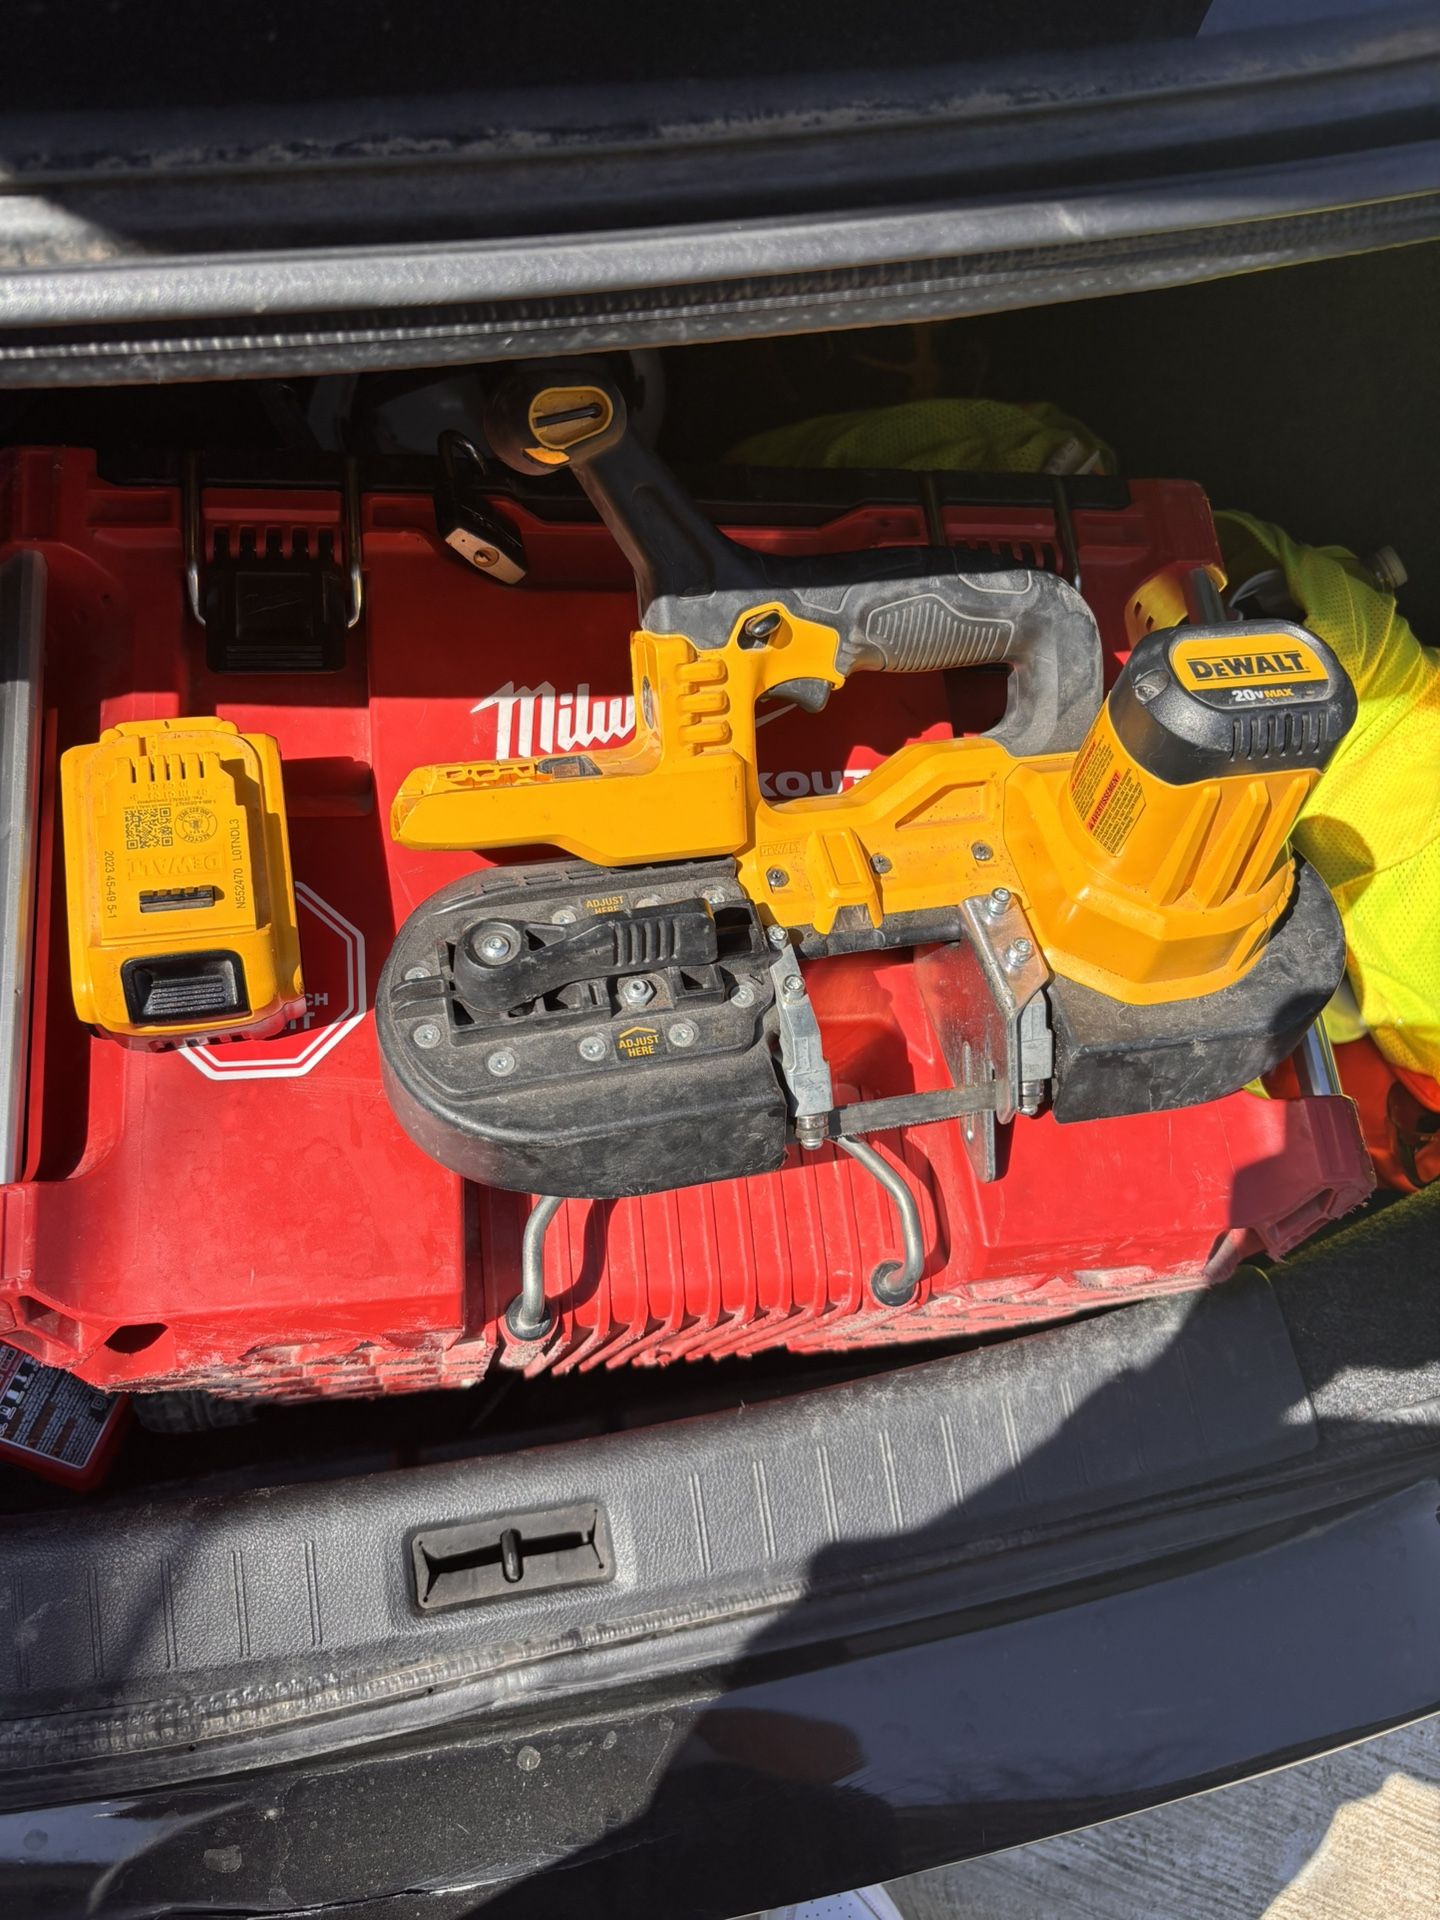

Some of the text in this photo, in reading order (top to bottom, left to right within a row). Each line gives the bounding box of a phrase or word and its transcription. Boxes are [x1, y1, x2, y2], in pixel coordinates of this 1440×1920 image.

[1187, 652, 1306, 680] DEWALT
[470, 681, 636, 760] Milw
[758, 769, 872, 797] KOUT
[1090, 771, 1120, 826] AVERTISSEMENT
[104, 850, 115, 873] 2023
[585, 896, 624, 909] ADJUST
[619, 1034, 660, 1049] ADJUST
[628, 1046, 656, 1058] HERE
